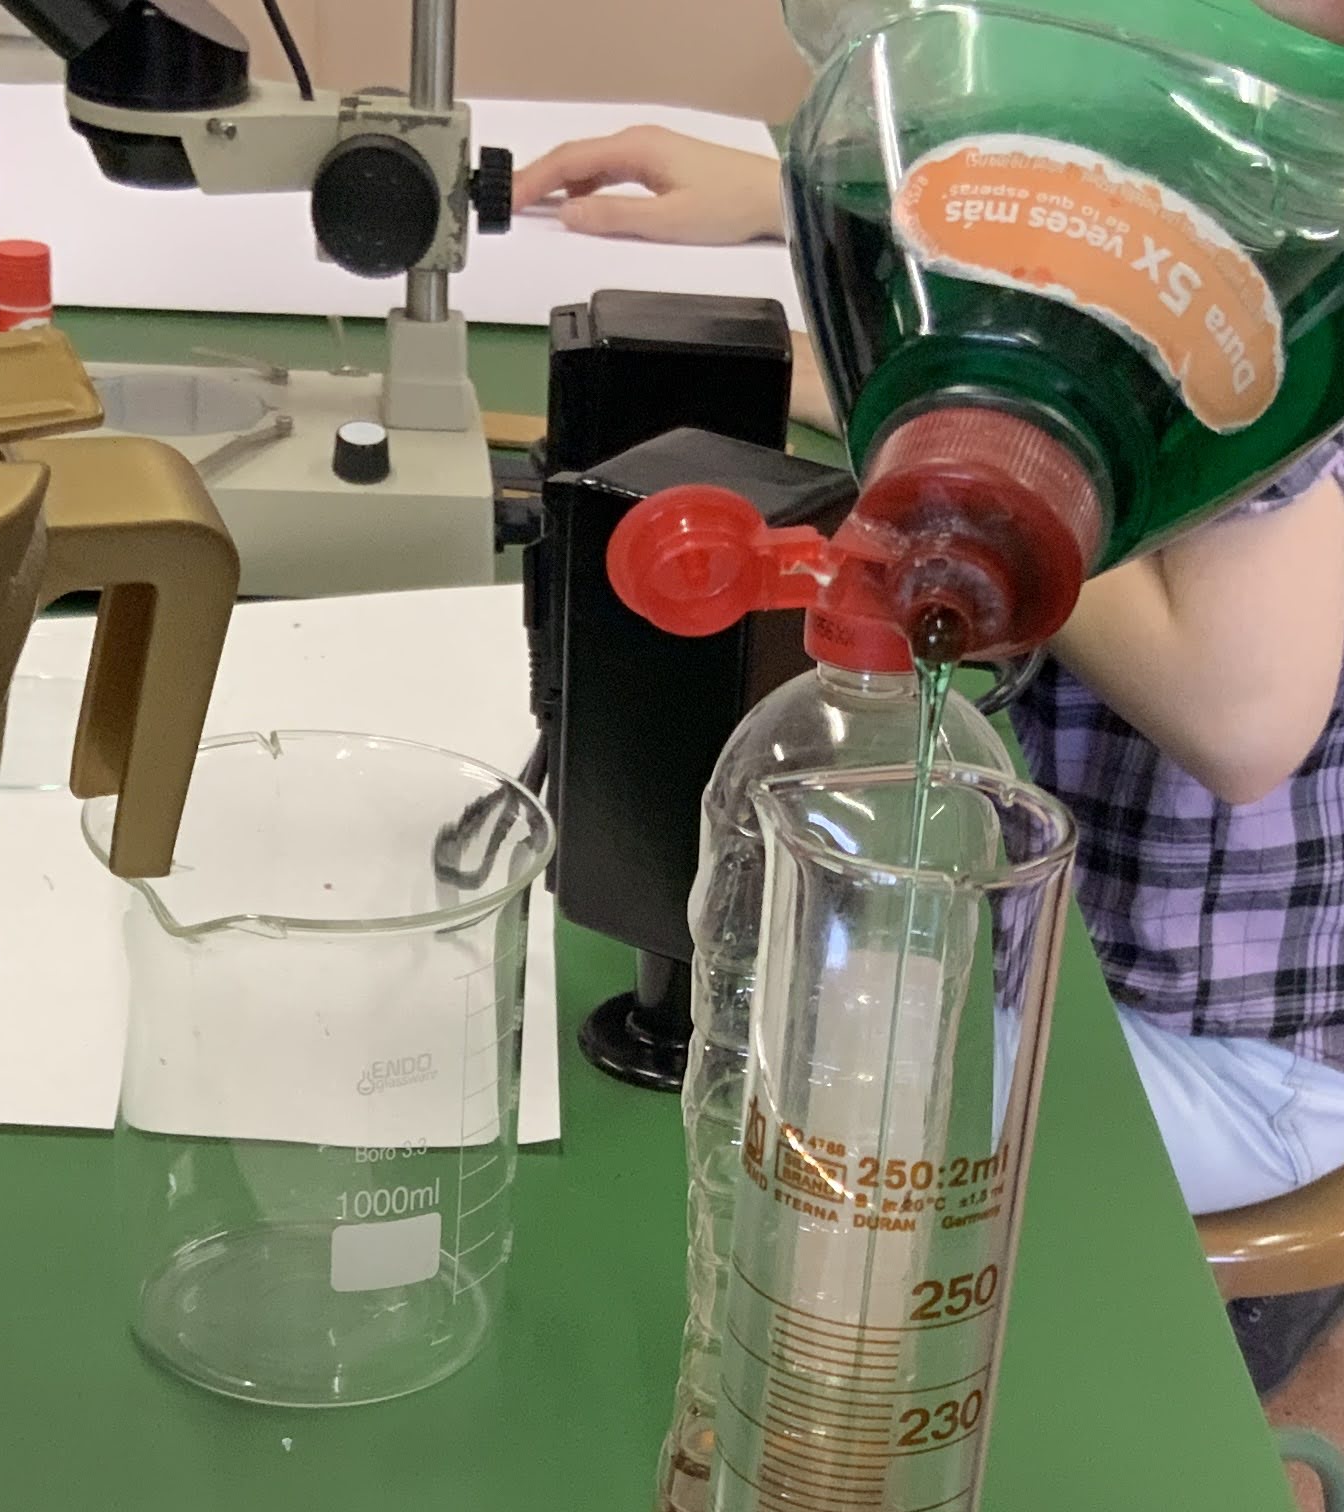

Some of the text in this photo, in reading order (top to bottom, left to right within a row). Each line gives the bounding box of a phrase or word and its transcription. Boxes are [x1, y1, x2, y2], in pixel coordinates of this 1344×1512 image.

[944, 200, 1020, 229] más
[1036, 192, 1075, 210] que
[1027, 206, 1124, 258] veces
[1205, 304, 1255, 395] Dura
[372, 1053, 433, 1079] ENDO
[356, 1137, 427, 1163] Boro 3.3
[336, 1177, 440, 1218] 1000ml
[853, 1214, 916, 1231] DURAN
[910, 1263, 998, 1320] 250
[896, 1389, 982, 1447] 230
